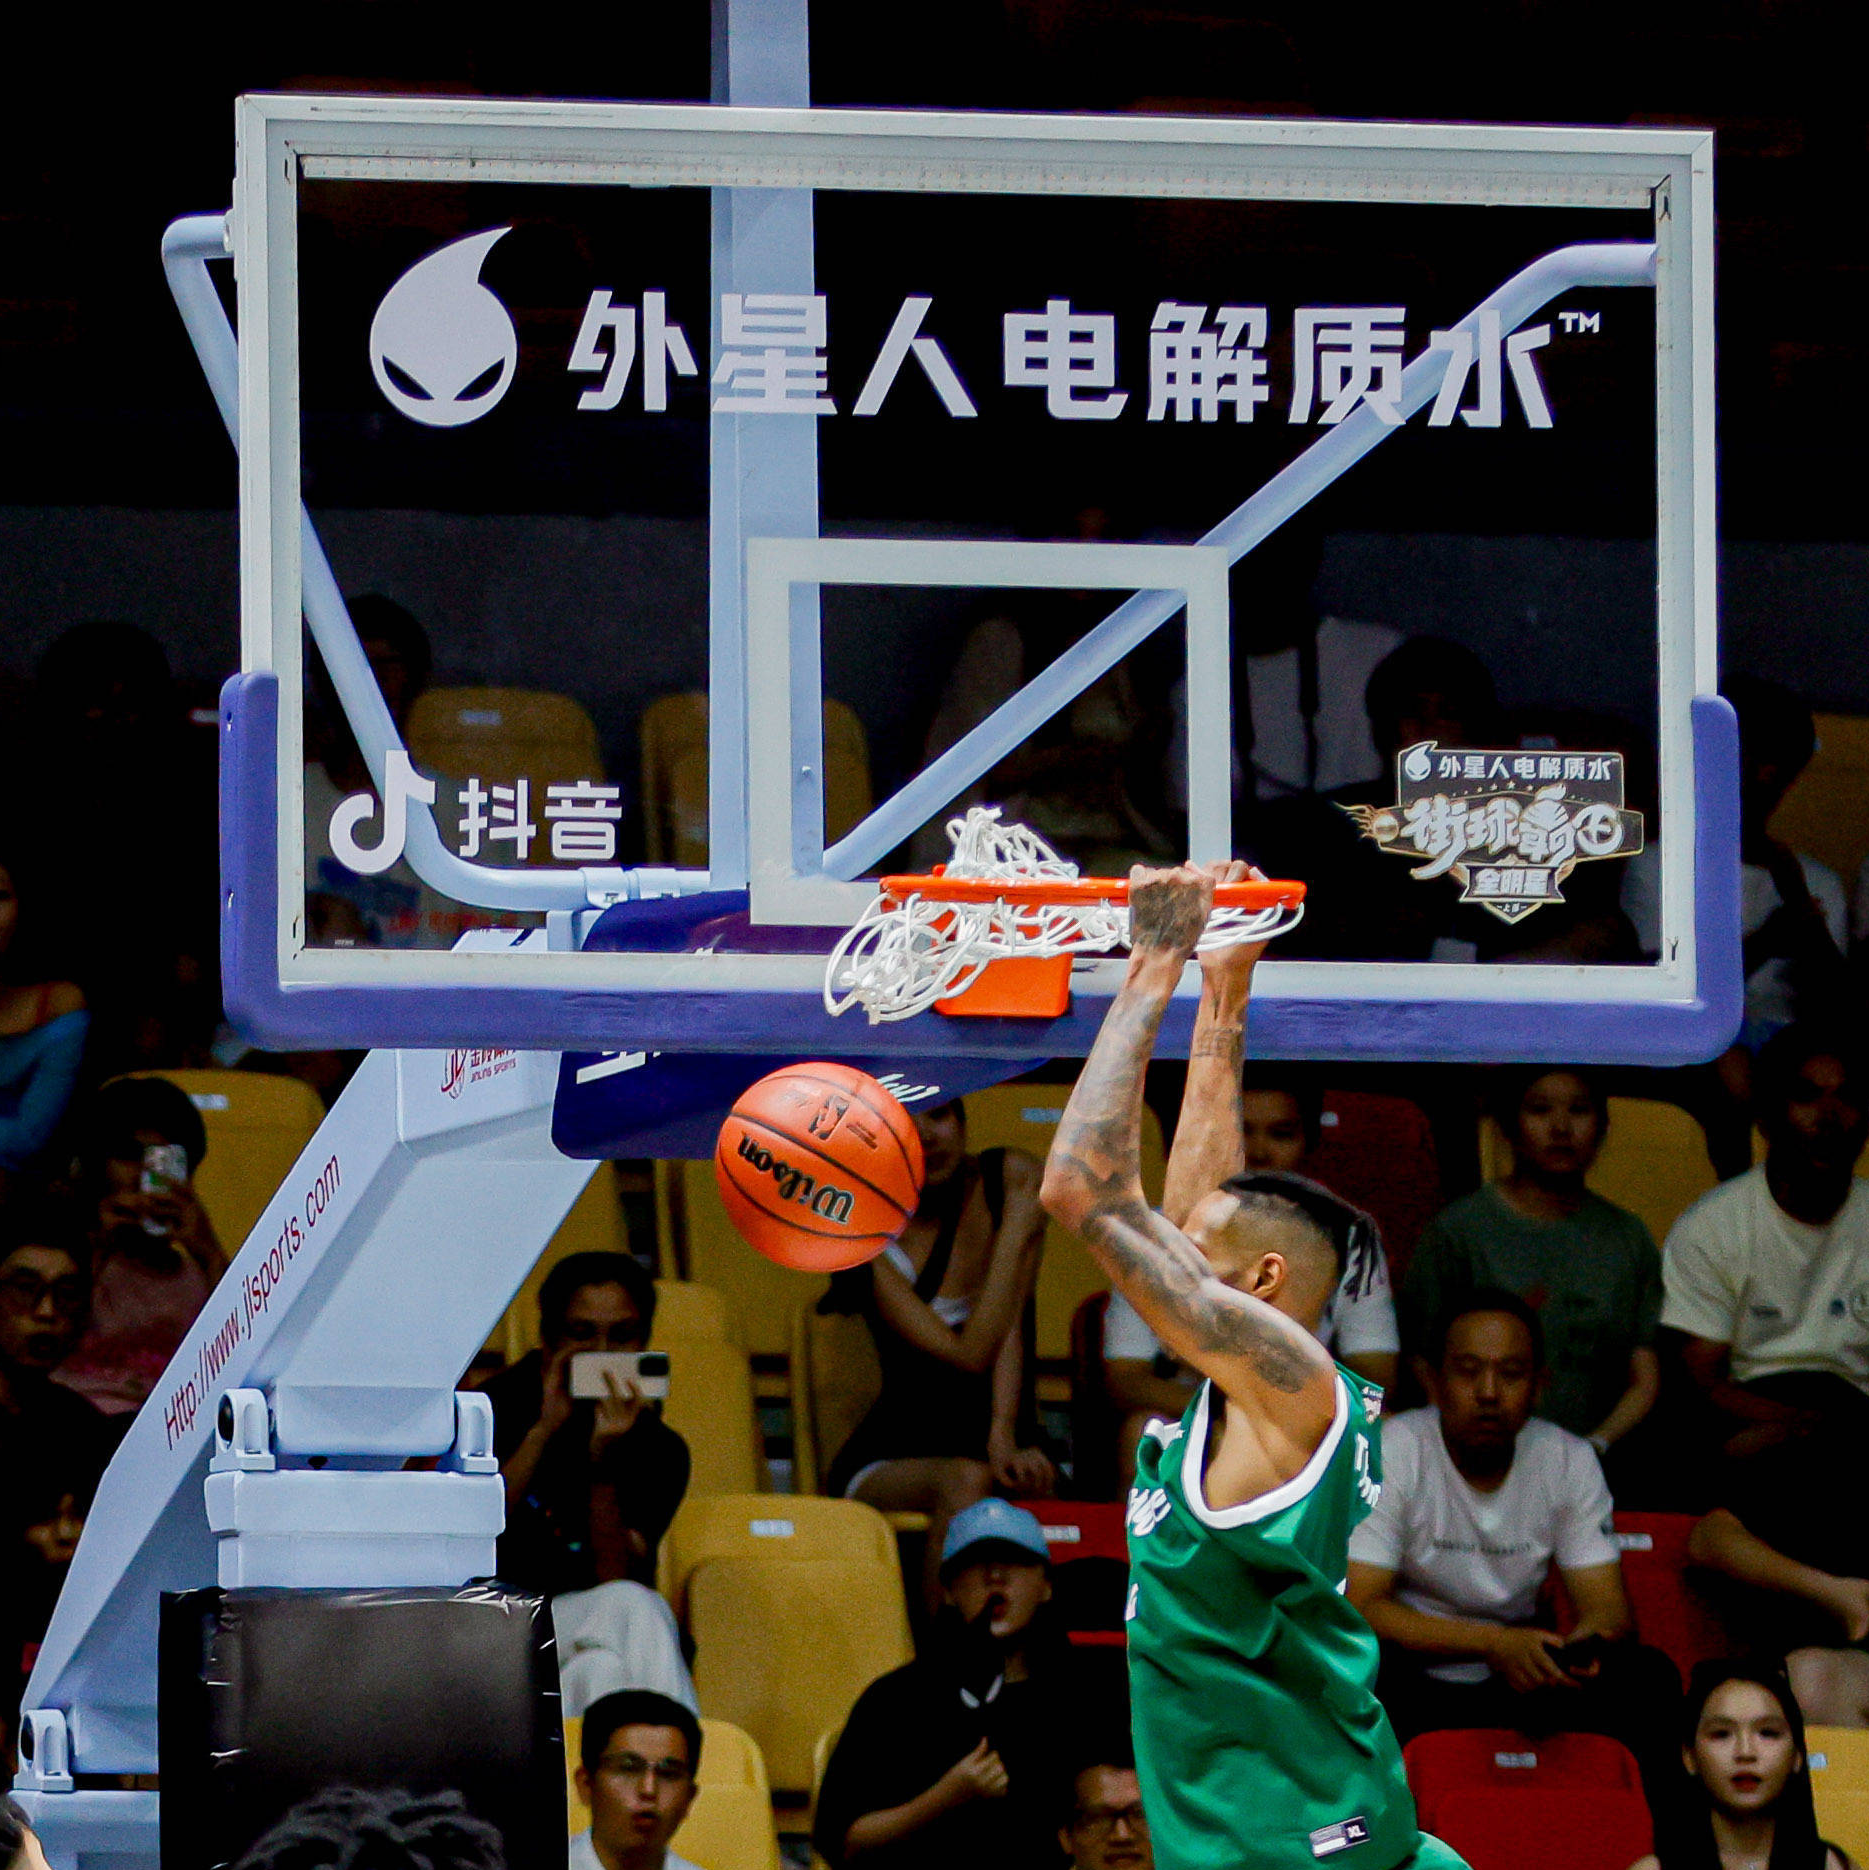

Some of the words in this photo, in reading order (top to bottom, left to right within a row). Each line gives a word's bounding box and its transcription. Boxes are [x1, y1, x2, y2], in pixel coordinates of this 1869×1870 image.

[567, 287, 1554, 429] 外星人电解质水
[457, 778, 623, 861] 抖音
[737, 1132, 855, 1226] Wilson
[1347, 1825, 1366, 1838] XL
